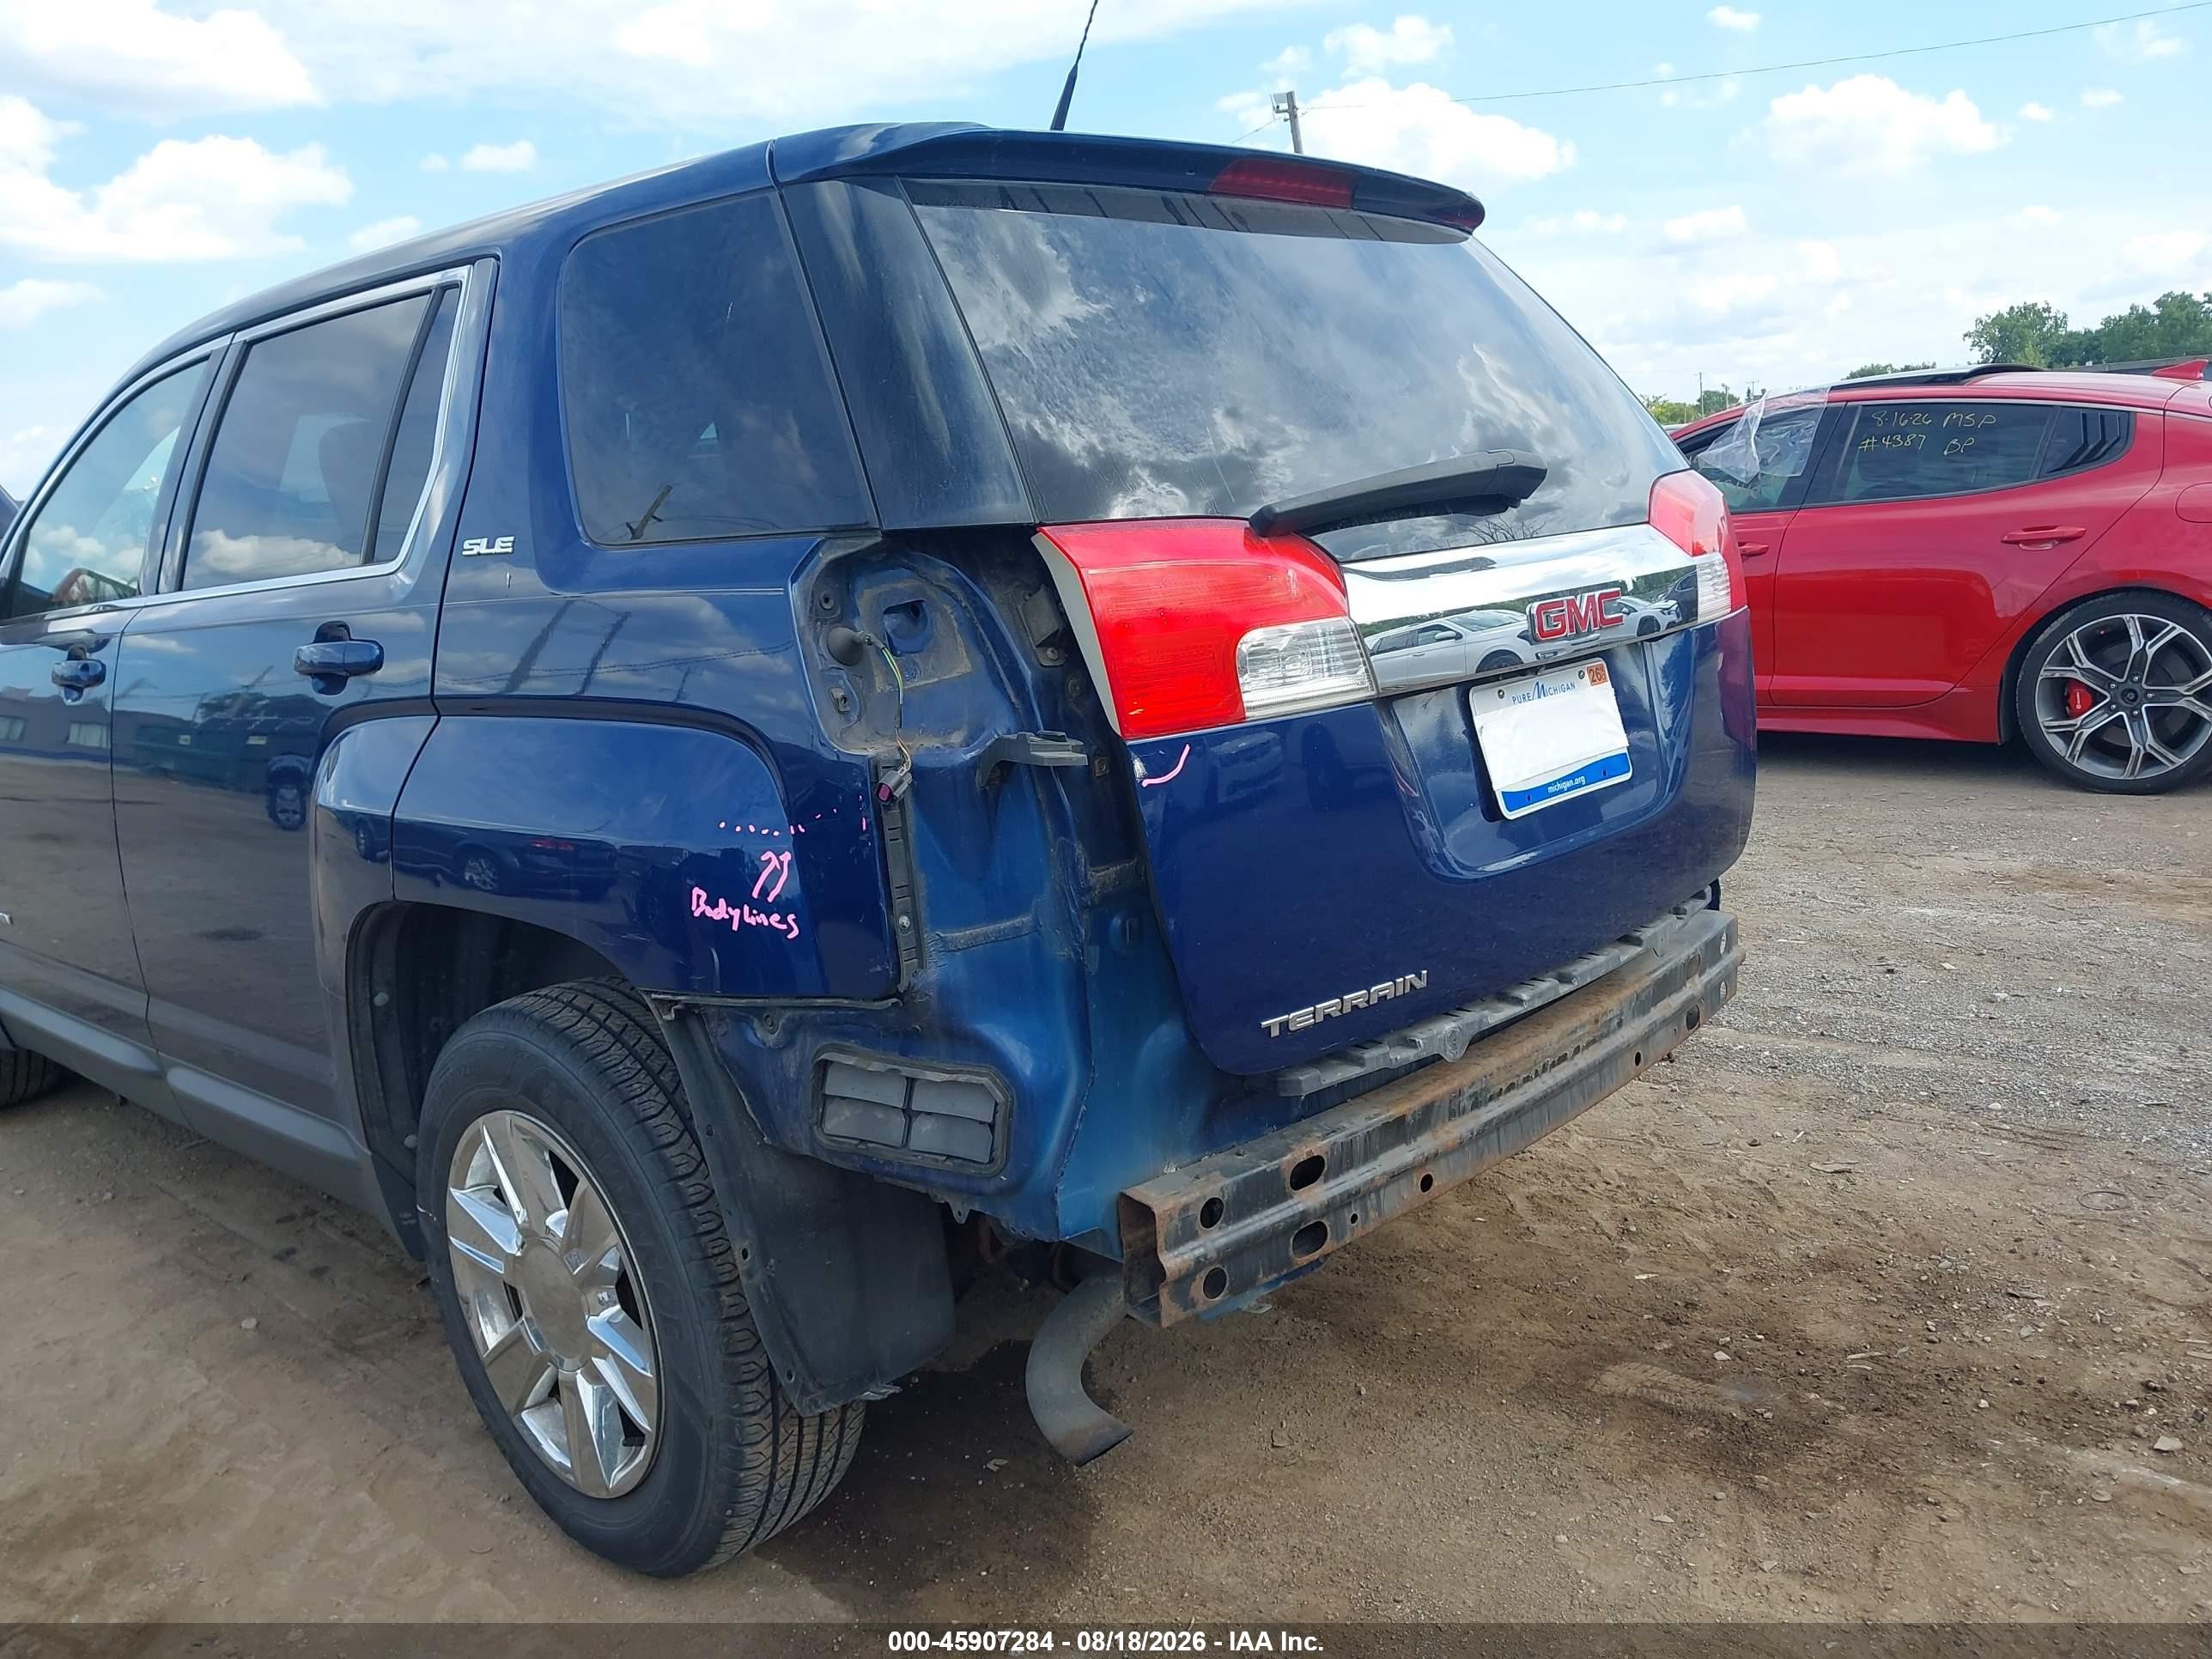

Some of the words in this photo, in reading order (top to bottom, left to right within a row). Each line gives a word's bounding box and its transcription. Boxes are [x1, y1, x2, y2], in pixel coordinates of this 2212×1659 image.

[1942, 411, 1997, 428] MSP
[1857, 434, 1927, 453] #4387
[1943, 437, 1976, 455] BP
[461, 535, 515, 556] SLE
[1534, 588, 1625, 641] GMC
[1511, 691, 1532, 705] PURE
[1532, 681, 1576, 700] MICHIGAN
[1547, 775, 1586, 794] michigan.org
[1261, 969, 1429, 1038] TERRAIN
